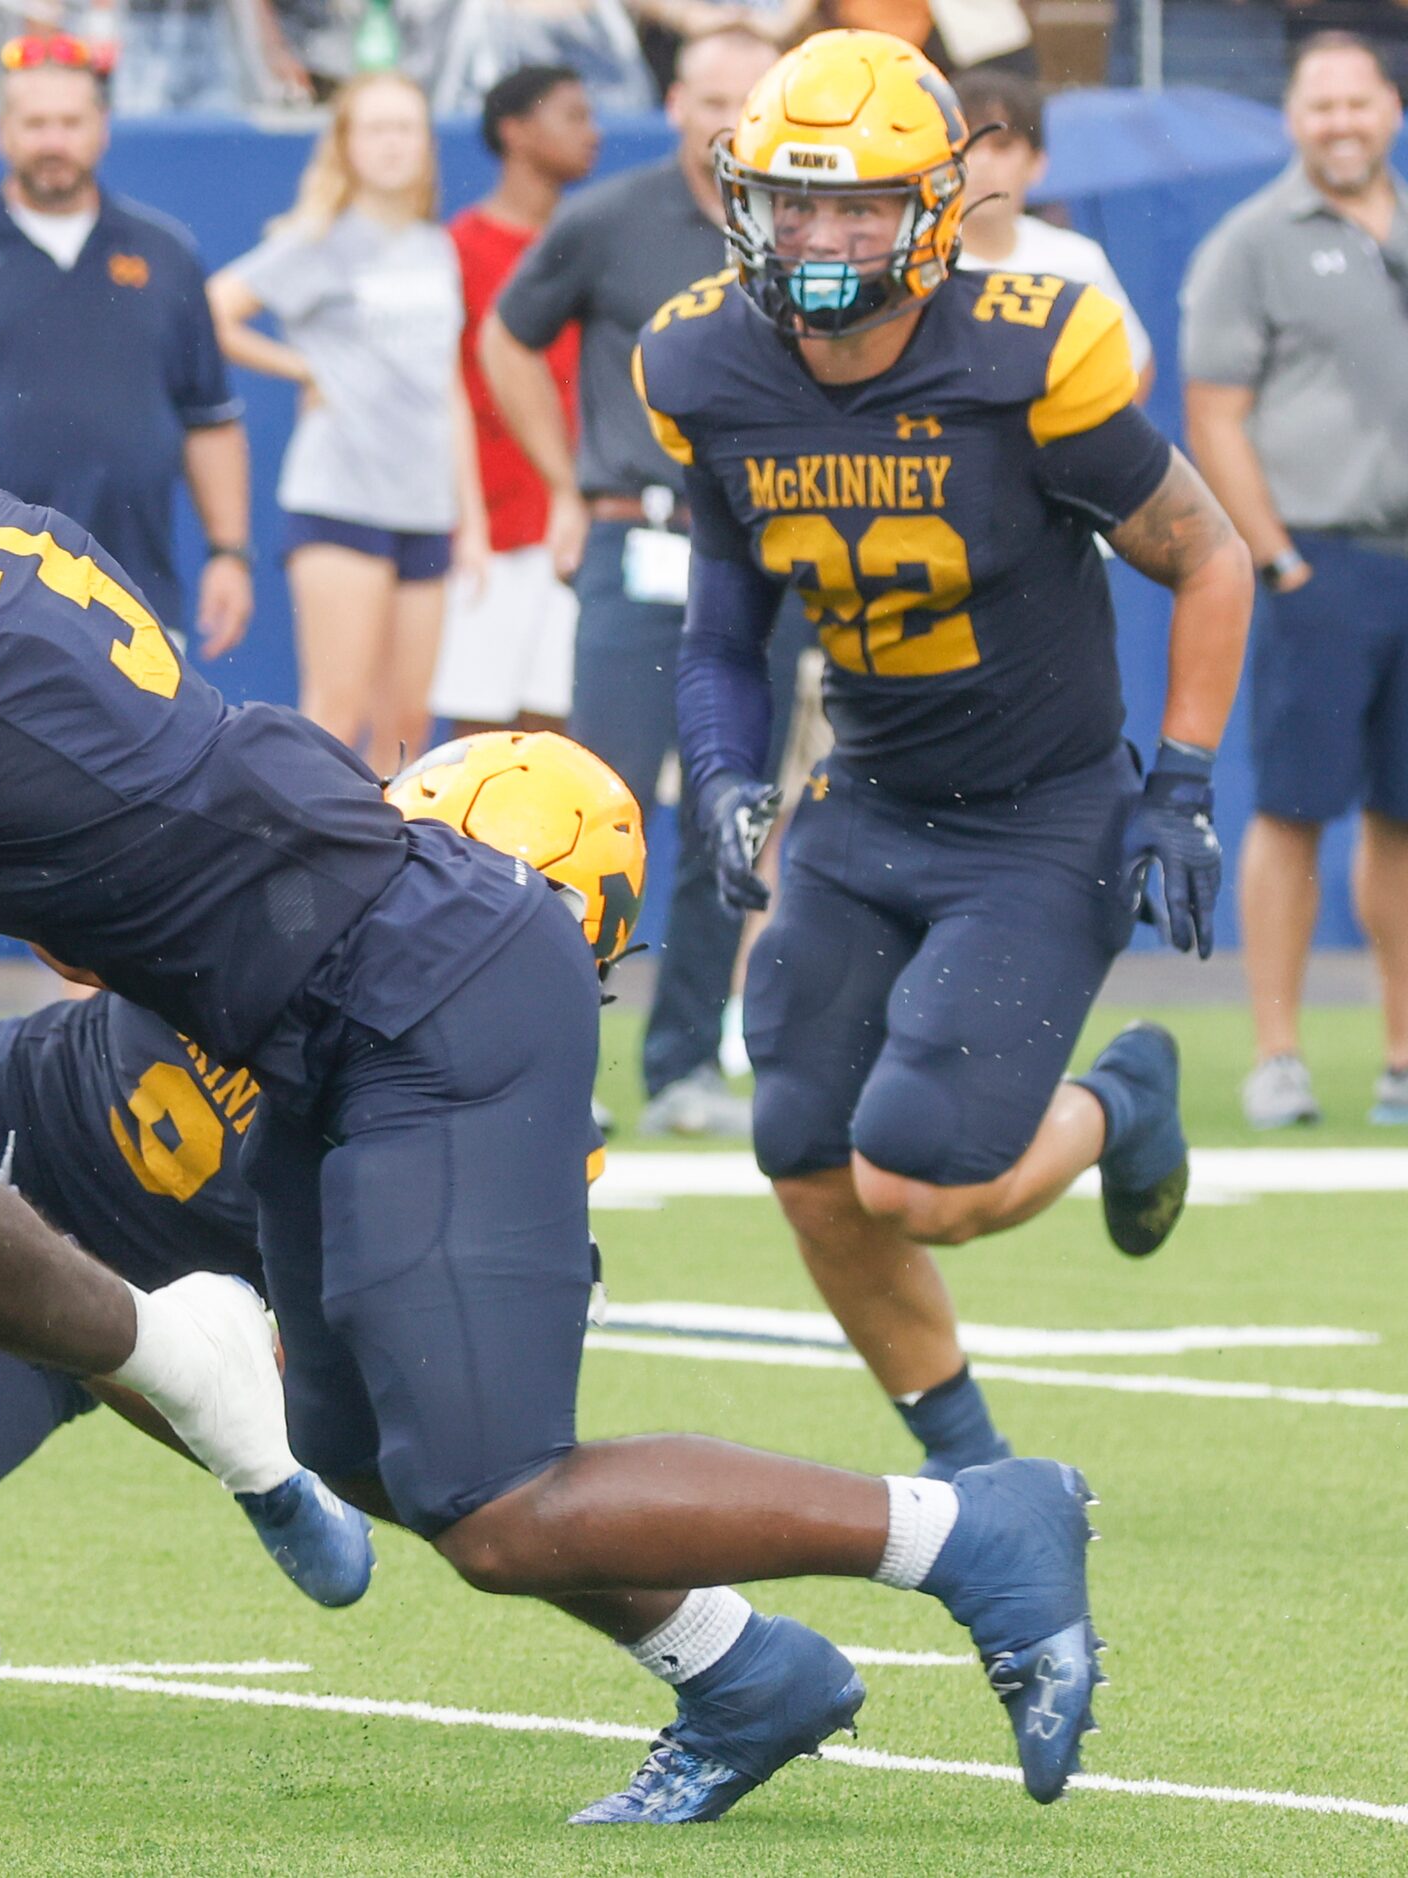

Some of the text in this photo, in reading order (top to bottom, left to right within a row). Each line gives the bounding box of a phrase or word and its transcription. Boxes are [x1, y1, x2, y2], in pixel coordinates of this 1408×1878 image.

[650, 268, 740, 334] 22
[972, 273, 1066, 329] 22
[744, 454, 952, 510] McKINNEY
[760, 514, 982, 677] 22
[109, 1061, 225, 1204] 9
